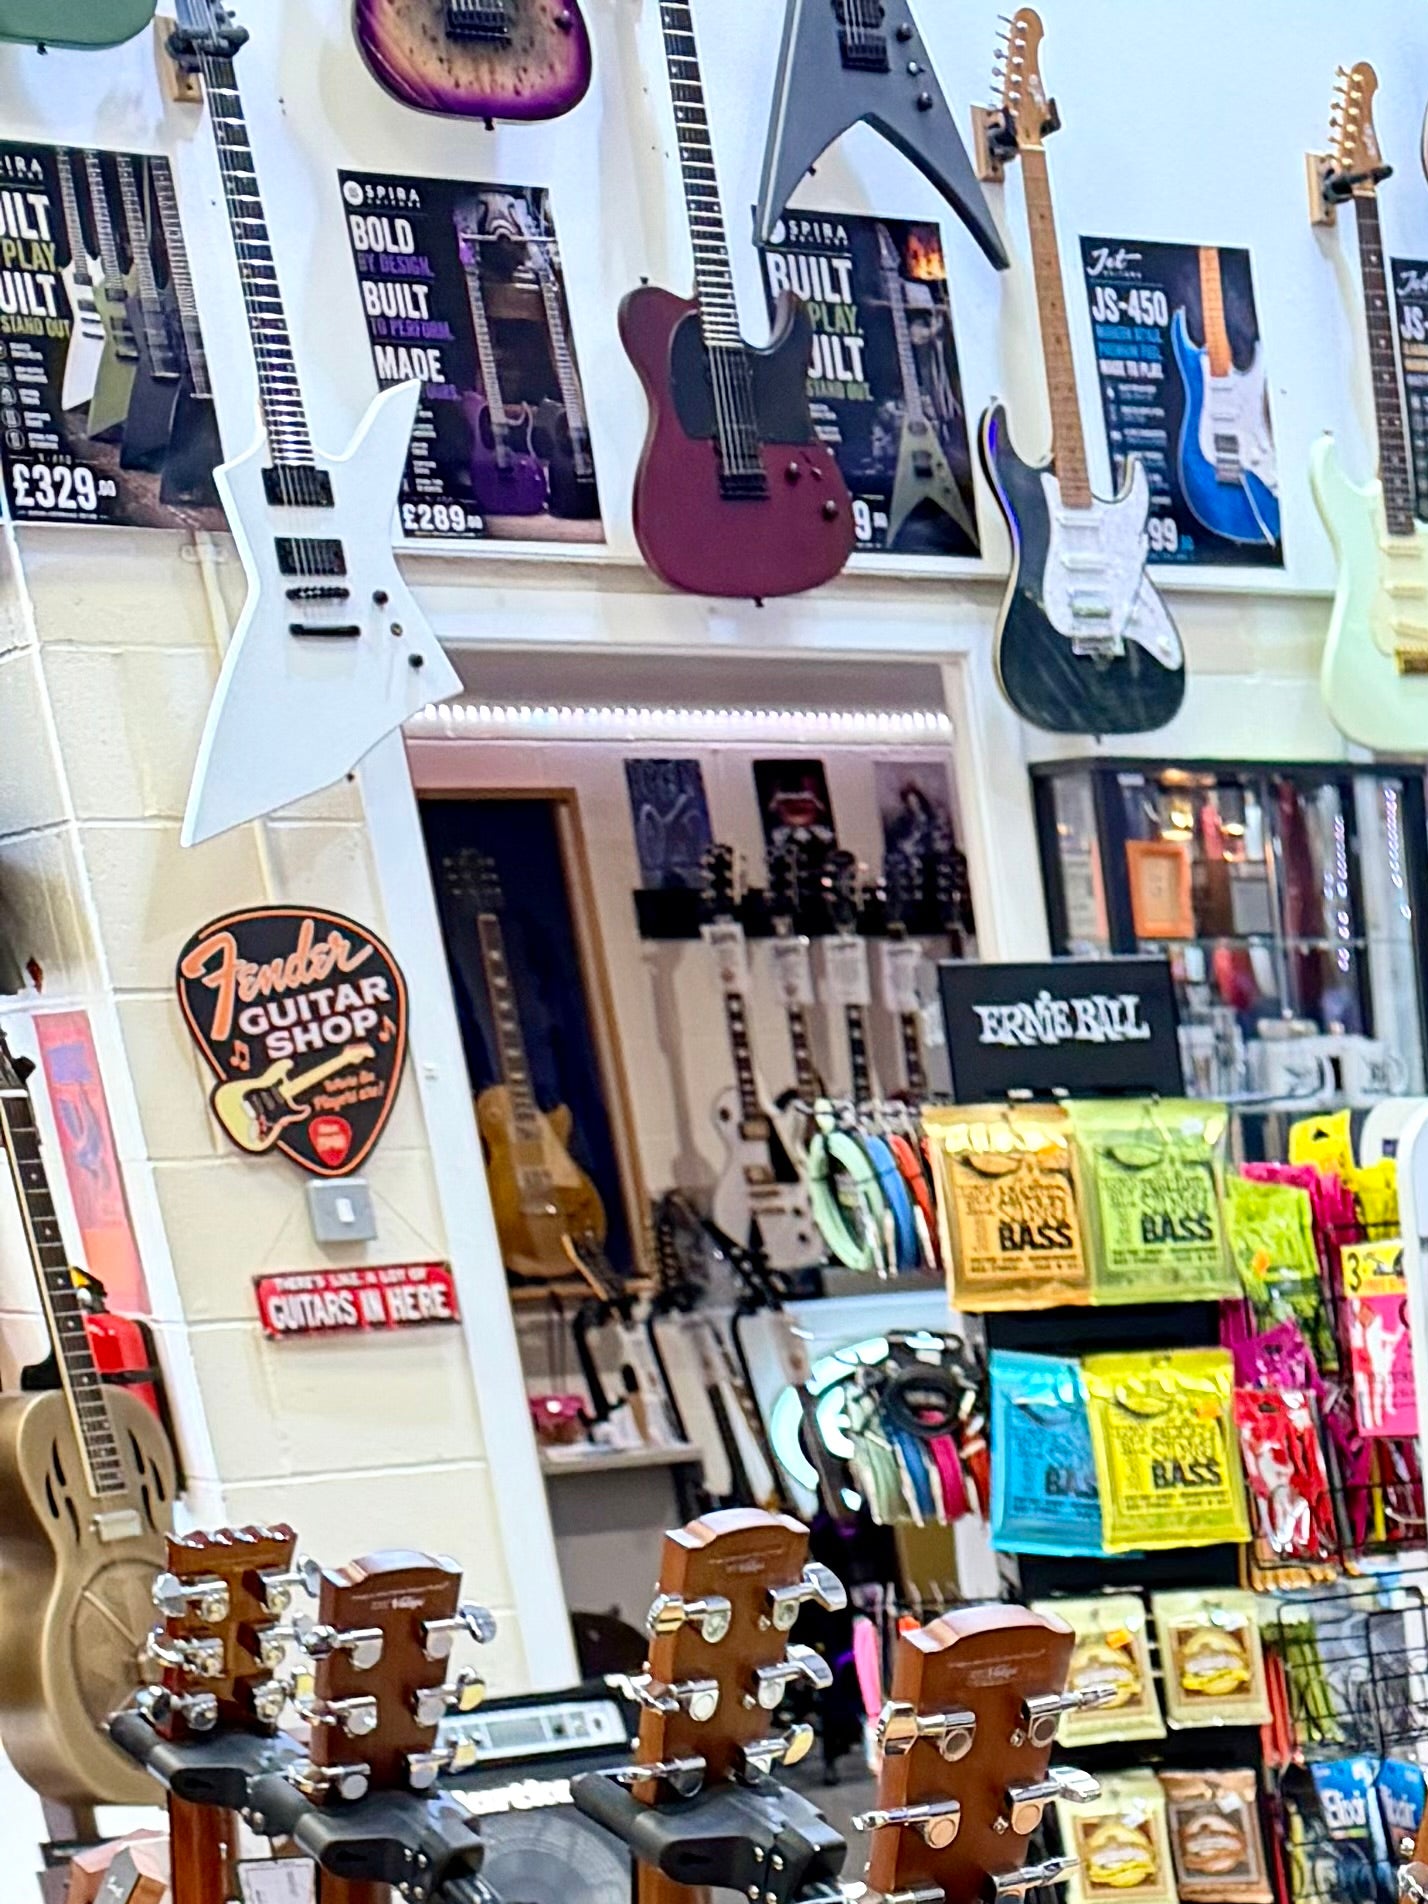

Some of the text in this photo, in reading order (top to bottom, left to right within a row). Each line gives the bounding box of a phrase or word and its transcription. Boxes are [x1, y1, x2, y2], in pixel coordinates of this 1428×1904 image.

[365, 184, 421, 204] SPIRA
[350, 215, 414, 254] BOLD
[788, 220, 849, 240] SPIRA
[358, 252, 375, 274] BY
[766, 252, 854, 304] BUILT
[361, 280, 429, 320] BUILT
[1092, 286, 1169, 328] JS-450
[374, 345, 446, 383] MADE
[181, 918, 375, 1043] Fender
[238, 975, 391, 1036] GUITAR
[972, 989, 1151, 1046] ERNIE BALL
[266, 1007, 380, 1060] SHOP
[999, 1220, 1073, 1251] BASS
[1141, 1213, 1214, 1244] BASS
[268, 1282, 452, 1331] GUITARS IN HERE
[1152, 1459, 1222, 1490] BASS
